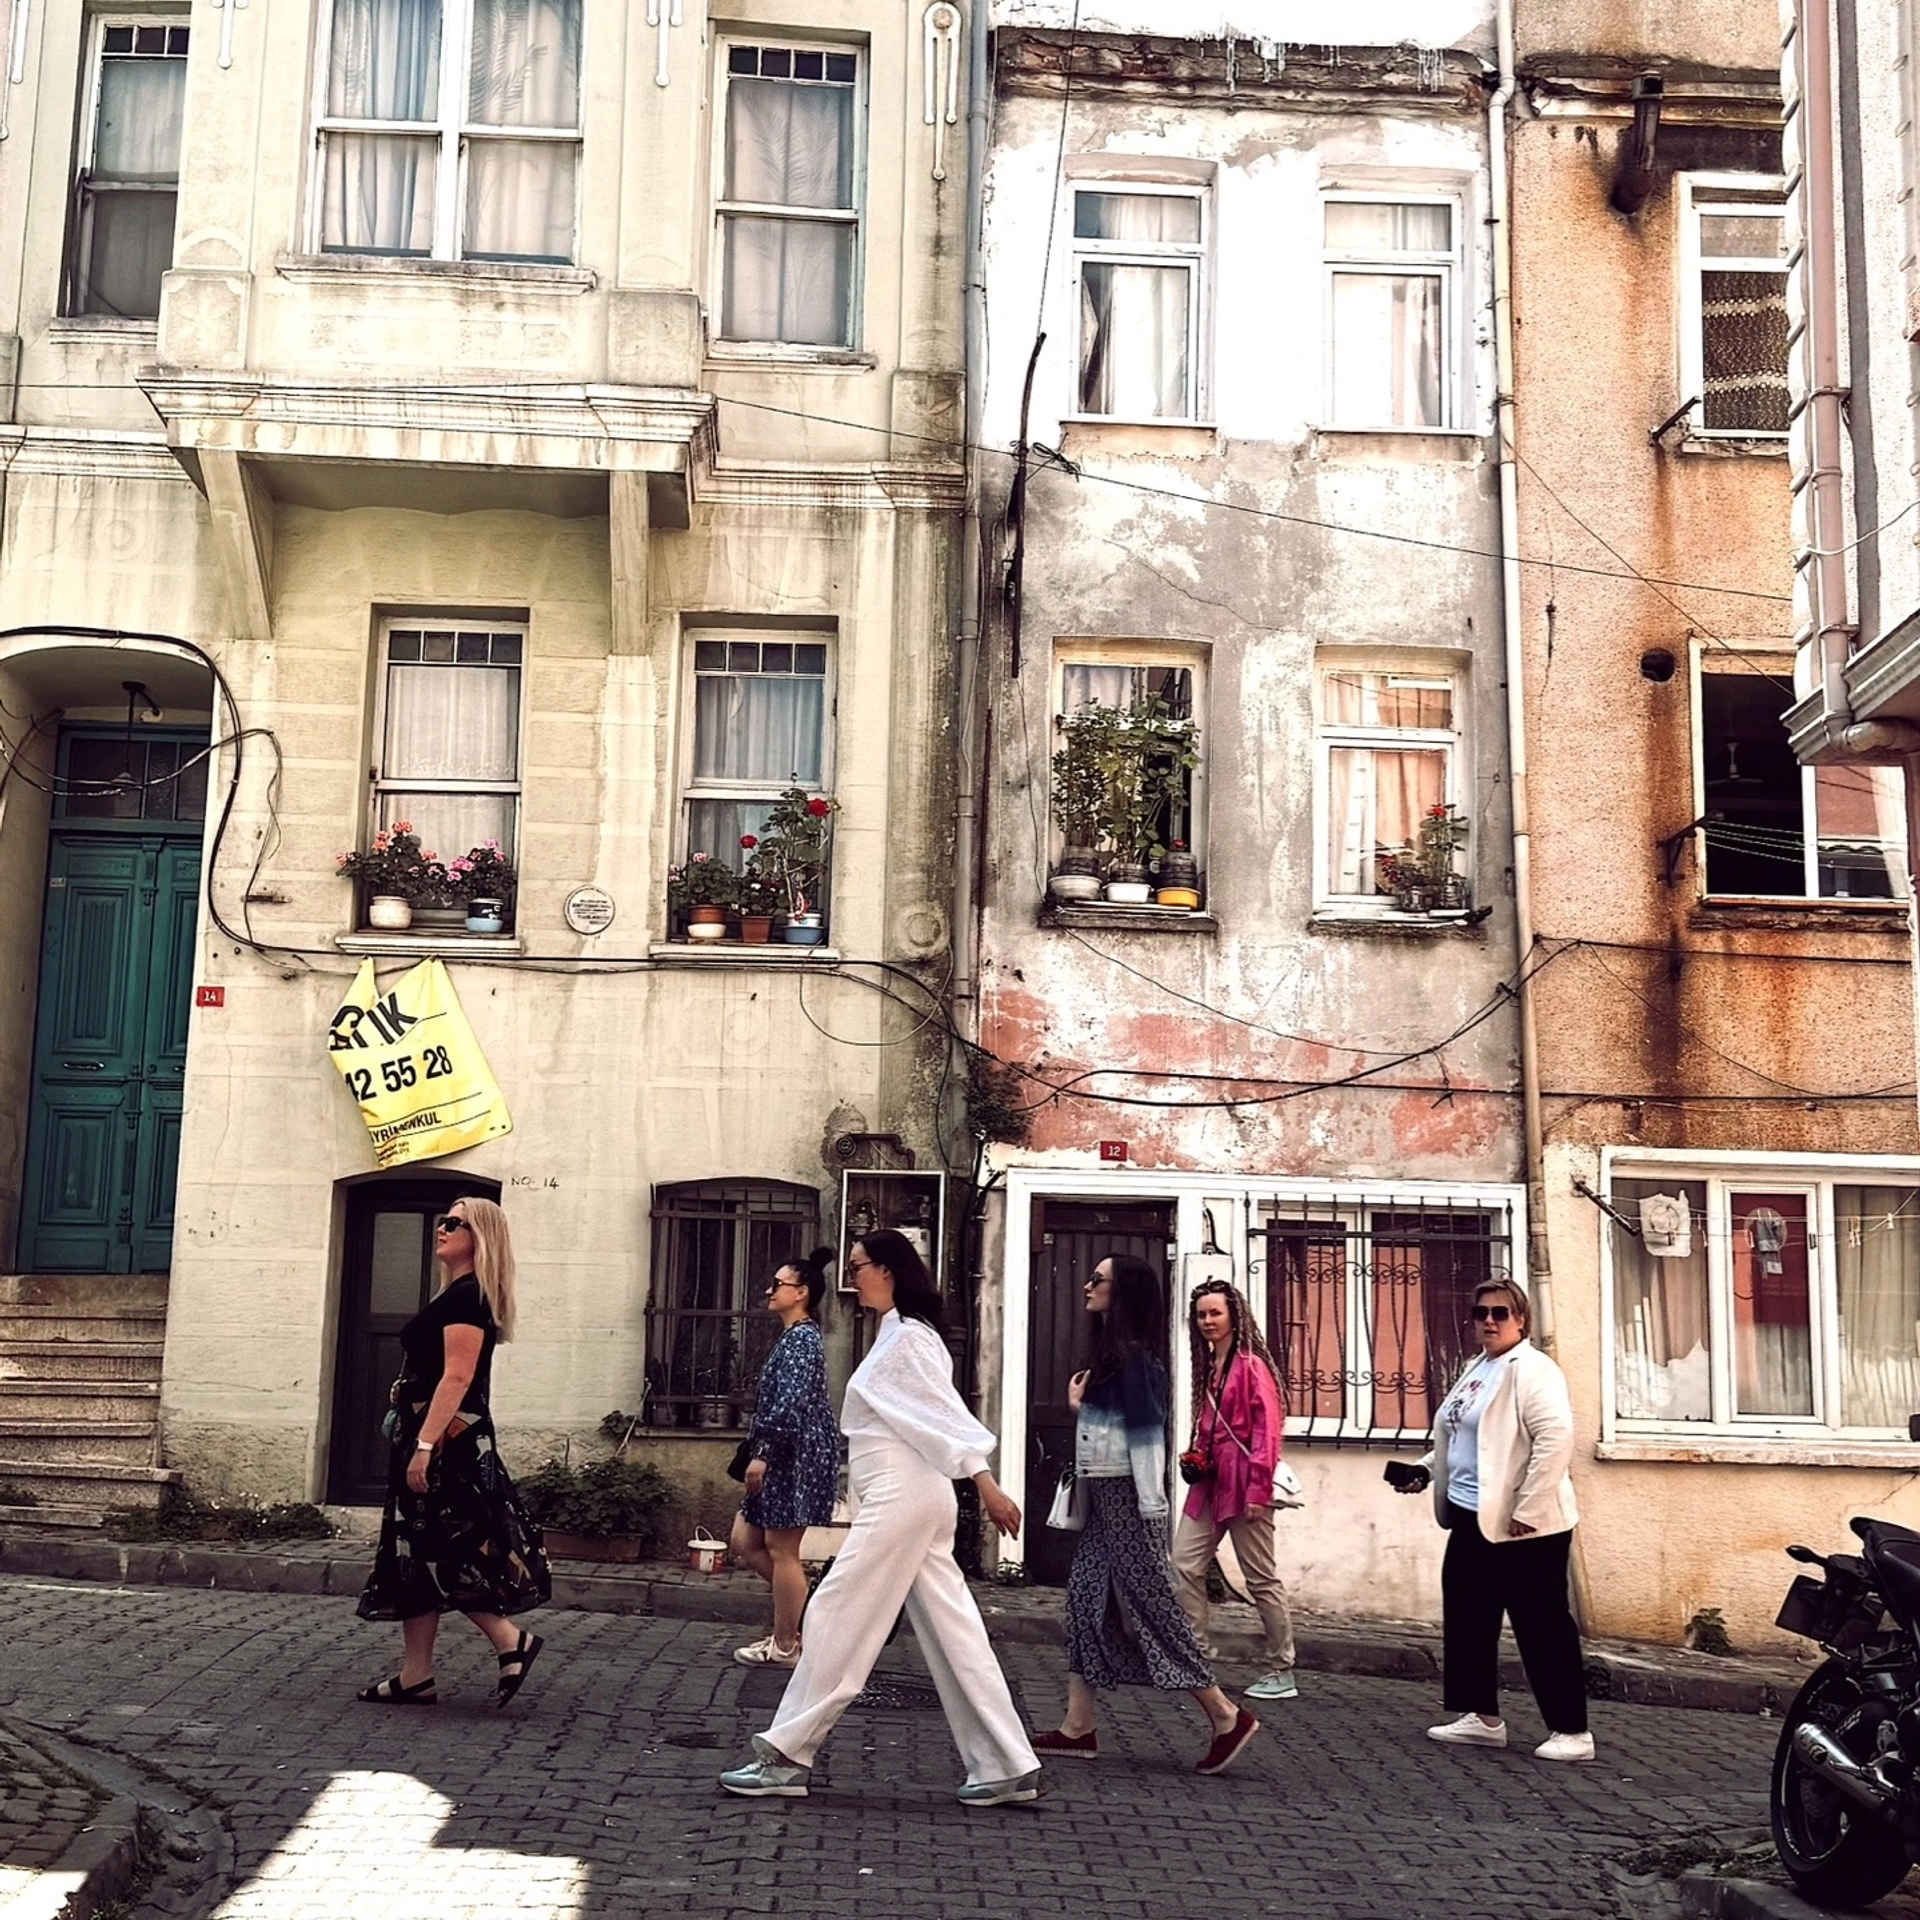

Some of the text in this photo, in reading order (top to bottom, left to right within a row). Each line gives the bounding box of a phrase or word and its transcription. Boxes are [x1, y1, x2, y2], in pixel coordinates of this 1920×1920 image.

[204, 990, 217, 1002] 14
[380, 1055, 418, 1093] 55
[422, 1045, 454, 1080] 28
[1108, 1145, 1121, 1157] 12
[544, 1177, 560, 1190] 14
